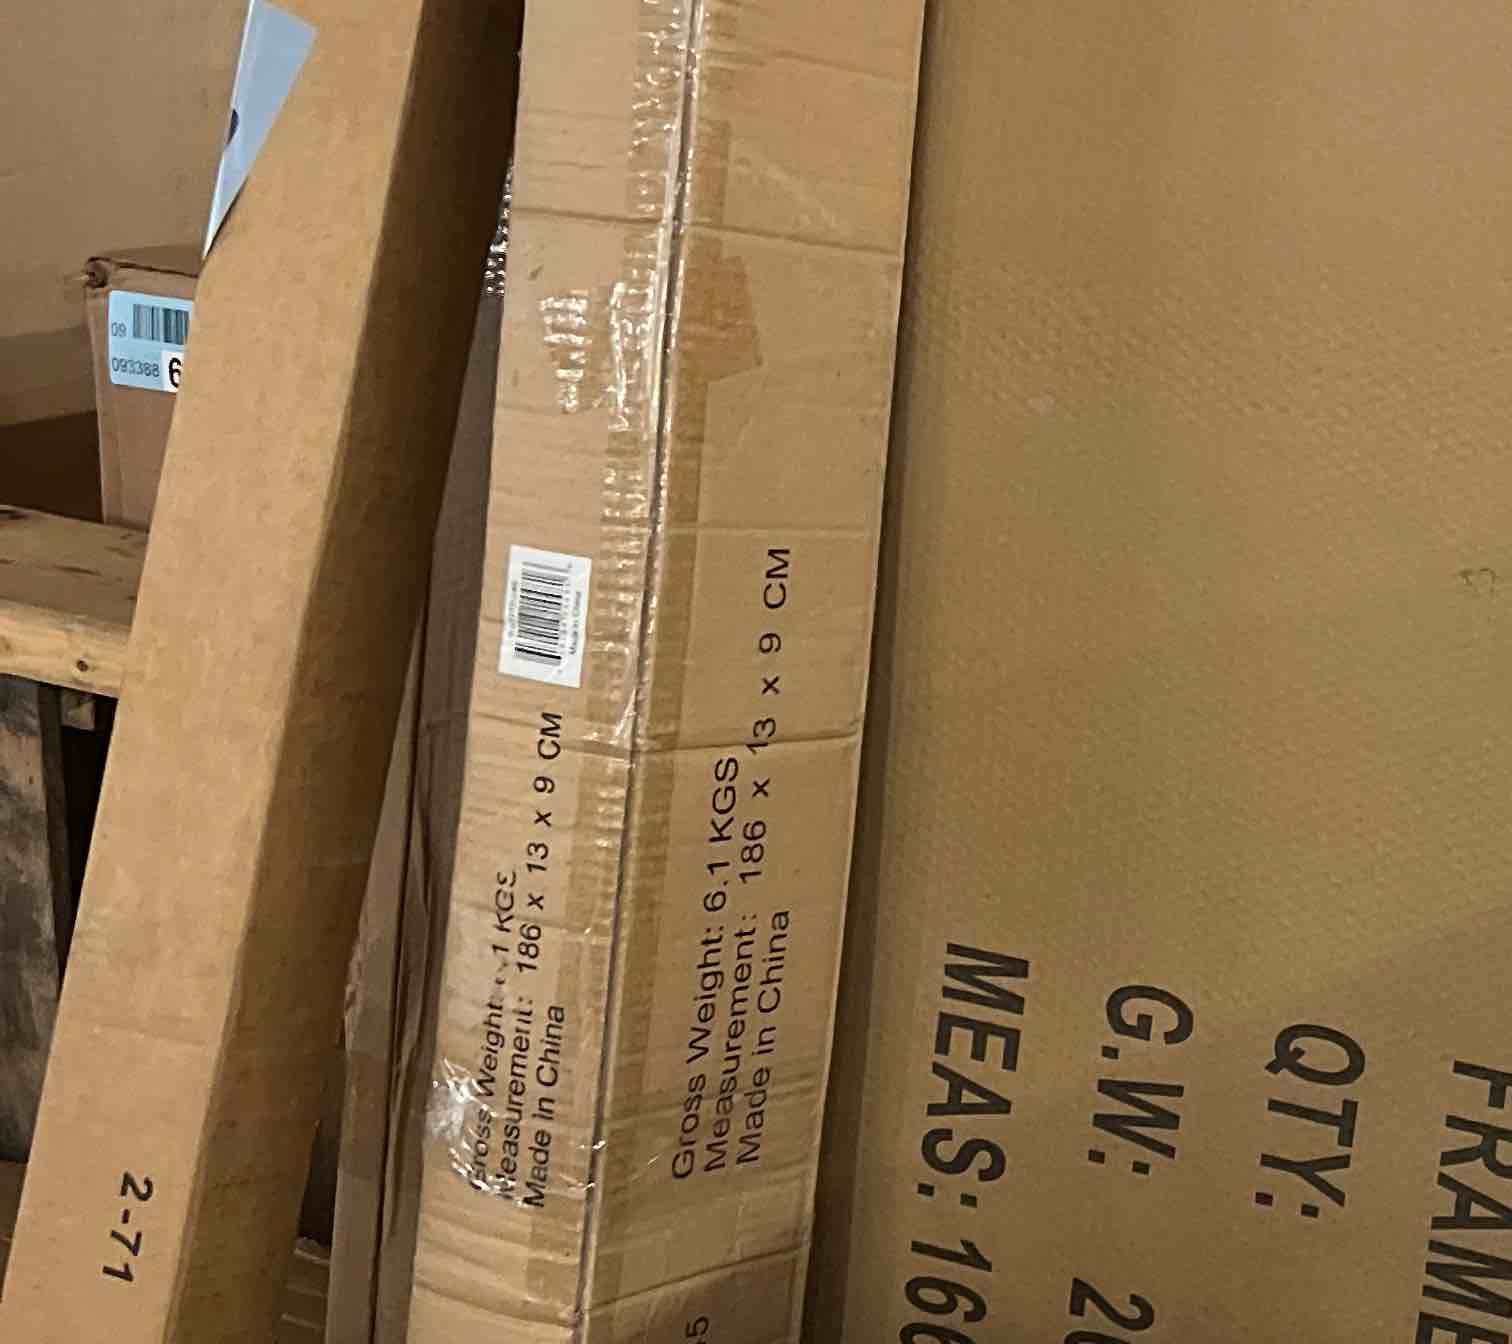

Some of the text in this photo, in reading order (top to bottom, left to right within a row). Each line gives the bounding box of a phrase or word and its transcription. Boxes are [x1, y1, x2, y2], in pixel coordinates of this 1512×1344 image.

[763, 548, 792, 609] CM
[758, 632, 783, 655] 9
[537, 712, 563, 760] CM
[745, 717, 778, 756] 13
[533, 776, 555, 794] 9
[526, 842, 549, 872] 13
[739, 820, 767, 884] 186
[516, 923, 541, 972] 186
[672, 757, 739, 1180] Gross Weight: 6.1 KGS
[535, 1006, 566, 1087] China
[703, 914, 757, 1172] Measurement:
[736, 911, 790, 1164] Made in China
[915, 940, 1031, 1209] MEAS:
[1087, 982, 1195, 1178] G.W:
[1255, 1021, 1366, 1219] QTY:
[522, 1129, 552, 1207] Made
[100, 1170, 154, 1283] 2-71
